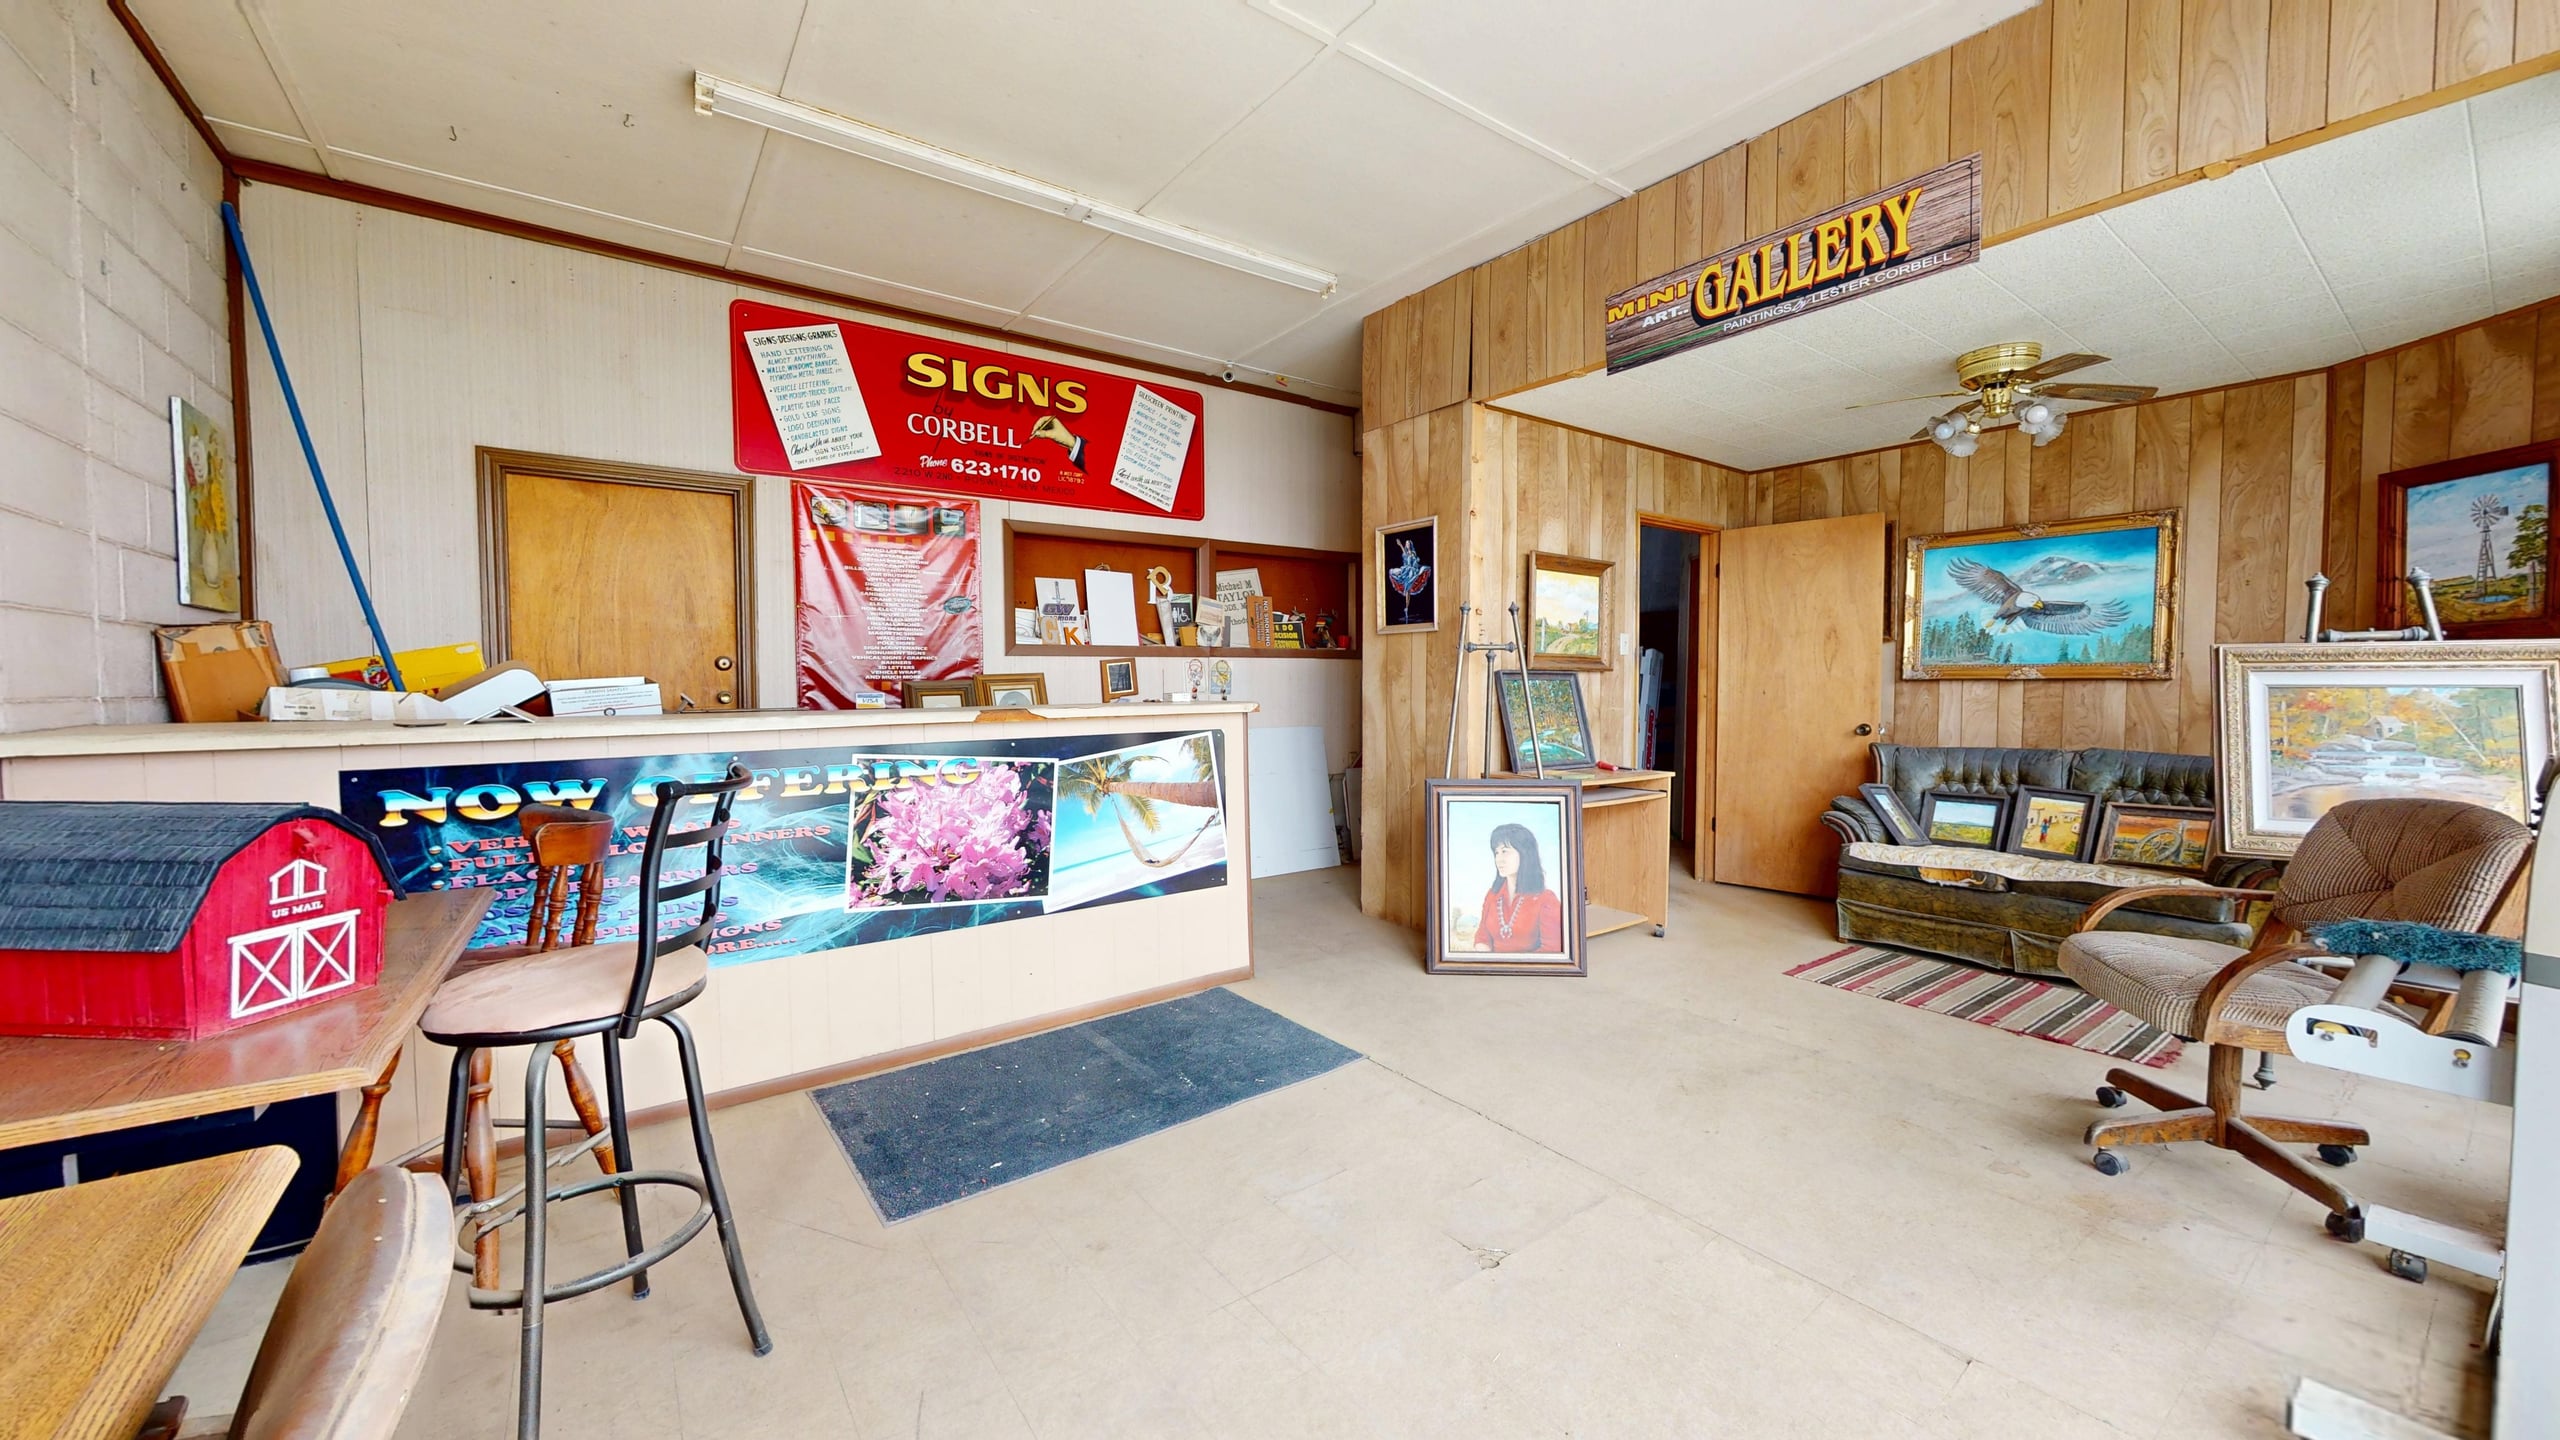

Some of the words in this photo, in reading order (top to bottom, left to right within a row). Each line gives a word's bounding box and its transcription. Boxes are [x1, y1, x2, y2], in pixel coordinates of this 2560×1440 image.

[1693, 186, 1924, 321] GALLERY
[1608, 280, 1688, 324] MINI
[1723, 303, 1792, 332] PAINTINGS
[1811, 278, 1871, 304] LESTER
[1875, 253, 1953, 284] CORBELL
[785, 346, 822, 354] LETTERING
[773, 384, 797, 392] VEHICLE
[798, 379, 830, 388] LETTERING
[907, 352, 1088, 414] SIGNS
[780, 403, 804, 411] PLASTIC
[1166, 405, 1186, 421] PRINTING
[806, 417, 841, 427] DESIGNING
[907, 413, 1022, 449] CORBELL
[790, 429, 829, 441] SANDBLASTED
[789, 442, 809, 455] Check
[919, 455, 948, 469] Phone
[894, 467, 922, 477] 2210
[936, 472, 952, 481] 2ND
[1017, 483, 1038, 492] NEW
[1042, 486, 1075, 496] MEXICO
[1216, 581, 1243, 592] Michael
[1245, 579, 1253, 588] M
[1063, 627, 1082, 646] K
[376, 778, 608, 827] NOW
[631, 757, 982, 808] OFFERING
[622, 819, 742, 838] WAS
[603, 862, 758, 890] BANNRS
[272, 908, 289, 919] US
[292, 901, 324, 915] MAIL
[619, 896, 740, 922] PINS
[595, 912, 729, 940] PHTO
[711, 920, 783, 940] IGNS
